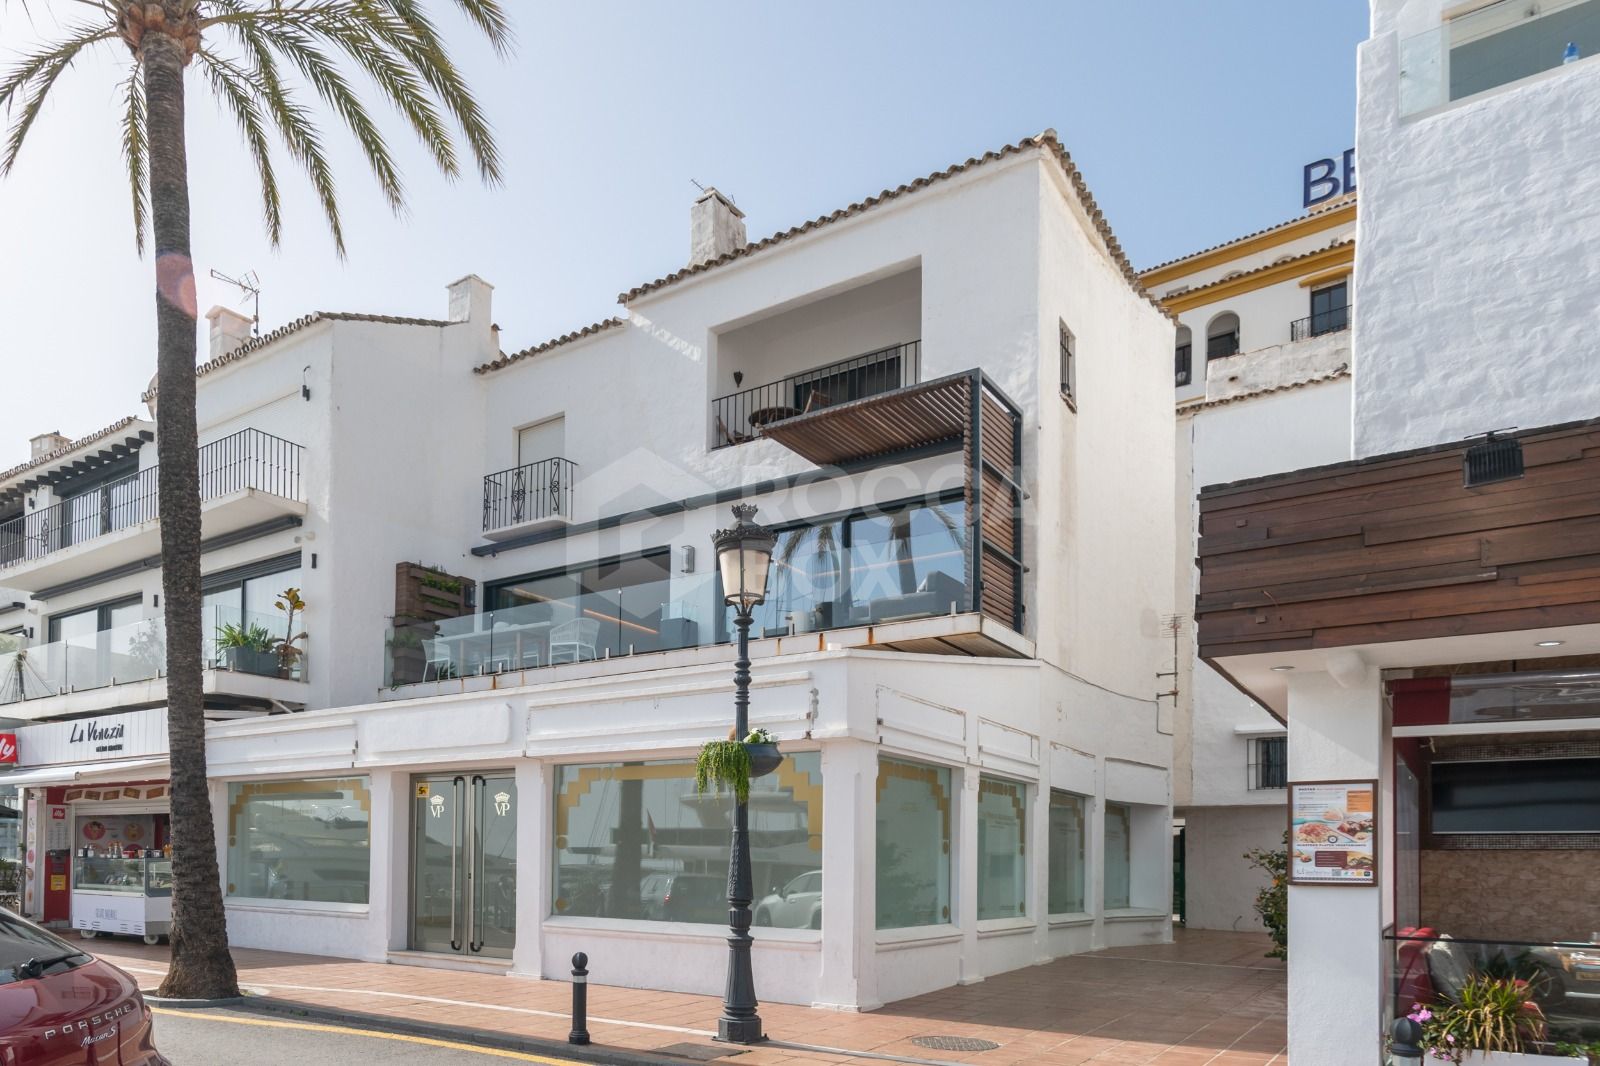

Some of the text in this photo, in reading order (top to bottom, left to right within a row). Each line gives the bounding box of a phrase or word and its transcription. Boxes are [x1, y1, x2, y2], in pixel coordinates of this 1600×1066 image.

[70, 720, 124, 743] La Venezia
[430, 805, 445, 818] VP
[494, 802, 510, 817] VP
[44, 1003, 133, 1041] PORSCHE
